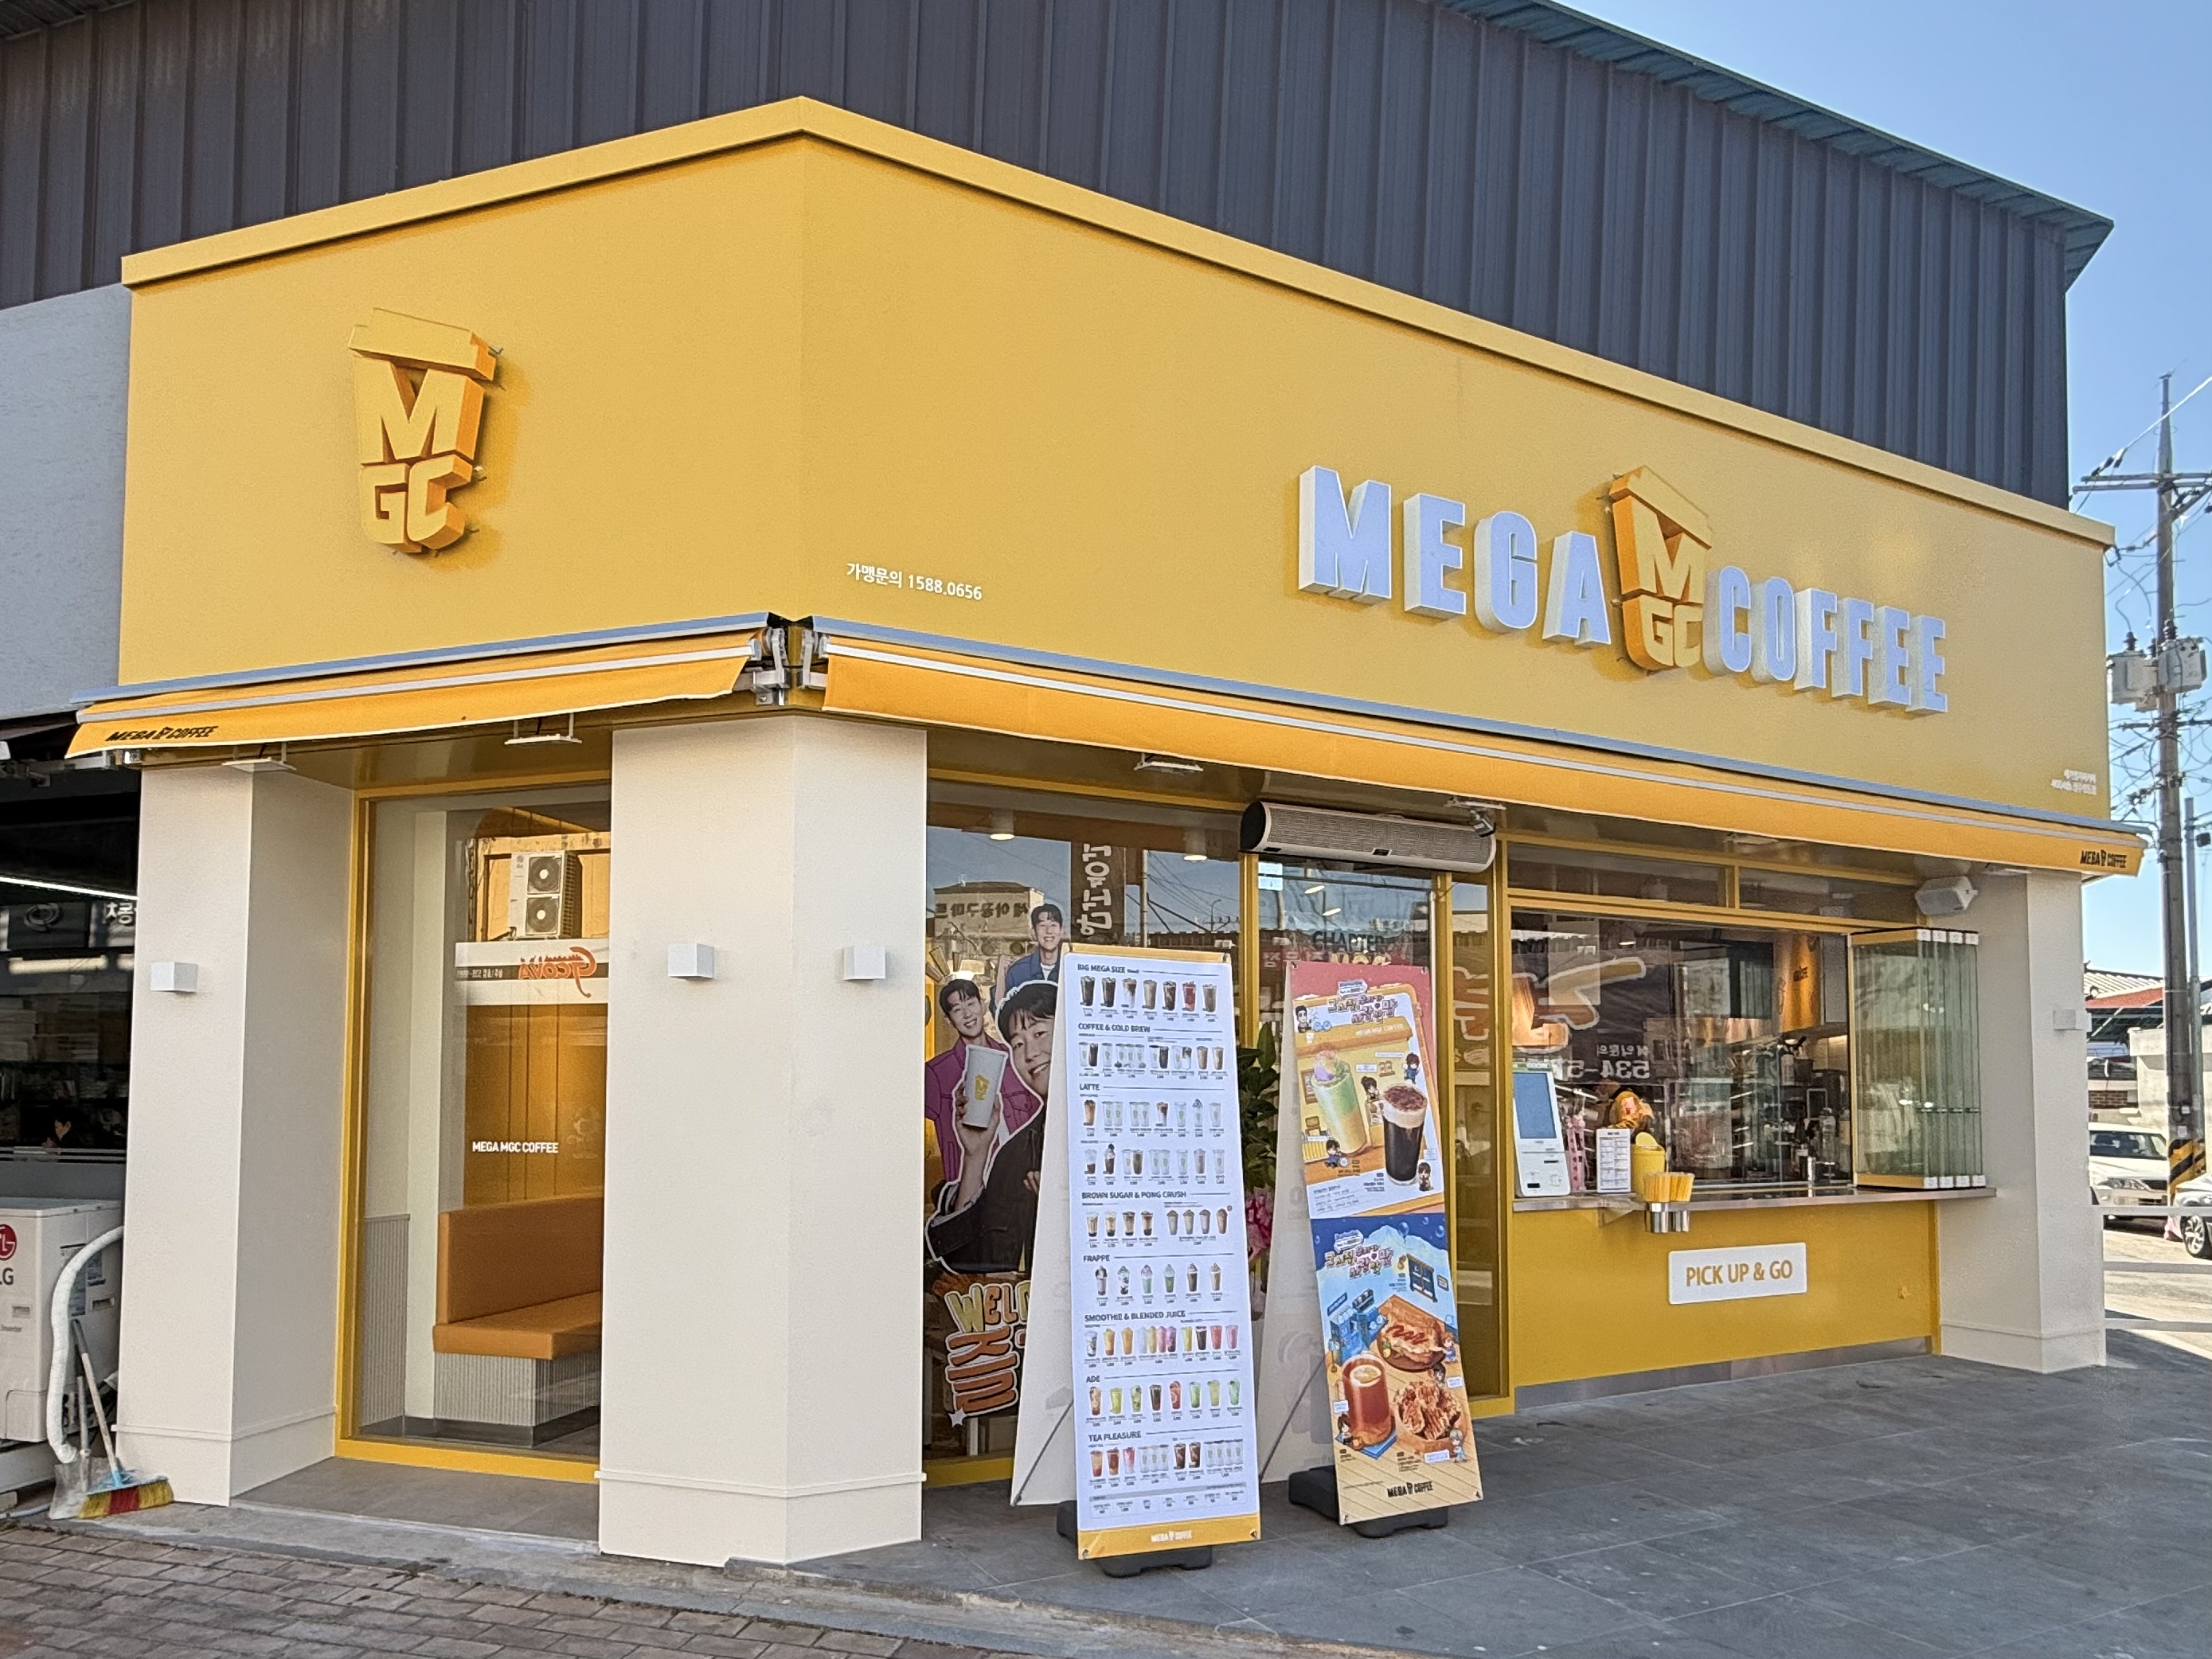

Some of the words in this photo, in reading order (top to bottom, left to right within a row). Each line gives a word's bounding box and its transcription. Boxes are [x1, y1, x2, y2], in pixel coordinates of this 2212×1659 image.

[846, 563, 903, 589] 가맹문의
[909, 575, 983, 600] 1588.0656
[1299, 465, 1611, 647] MEGA
[1702, 565, 1948, 714] COFFEE
[105, 731, 157, 742] MEGA
[166, 725, 218, 739] COFFEE
[2080, 850, 2101, 865] MEGA
[2107, 853, 2127, 868] COFFEE
[472, 1142, 499, 1152] MEGA
[500, 1142, 521, 1153] MGC
[522, 1142, 559, 1153] COFFEE
[1686, 1264, 1723, 1287] PICK
[1728, 1263, 1749, 1283] UP
[1753, 1262, 1765, 1281] &
[1769, 1259, 1793, 1280] GO
[1085, 1313, 1123, 1322] SMOOTHIE
[1104, 1431, 1141, 1441] PLEASURE
[1387, 1485, 1407, 1497] MEGA
